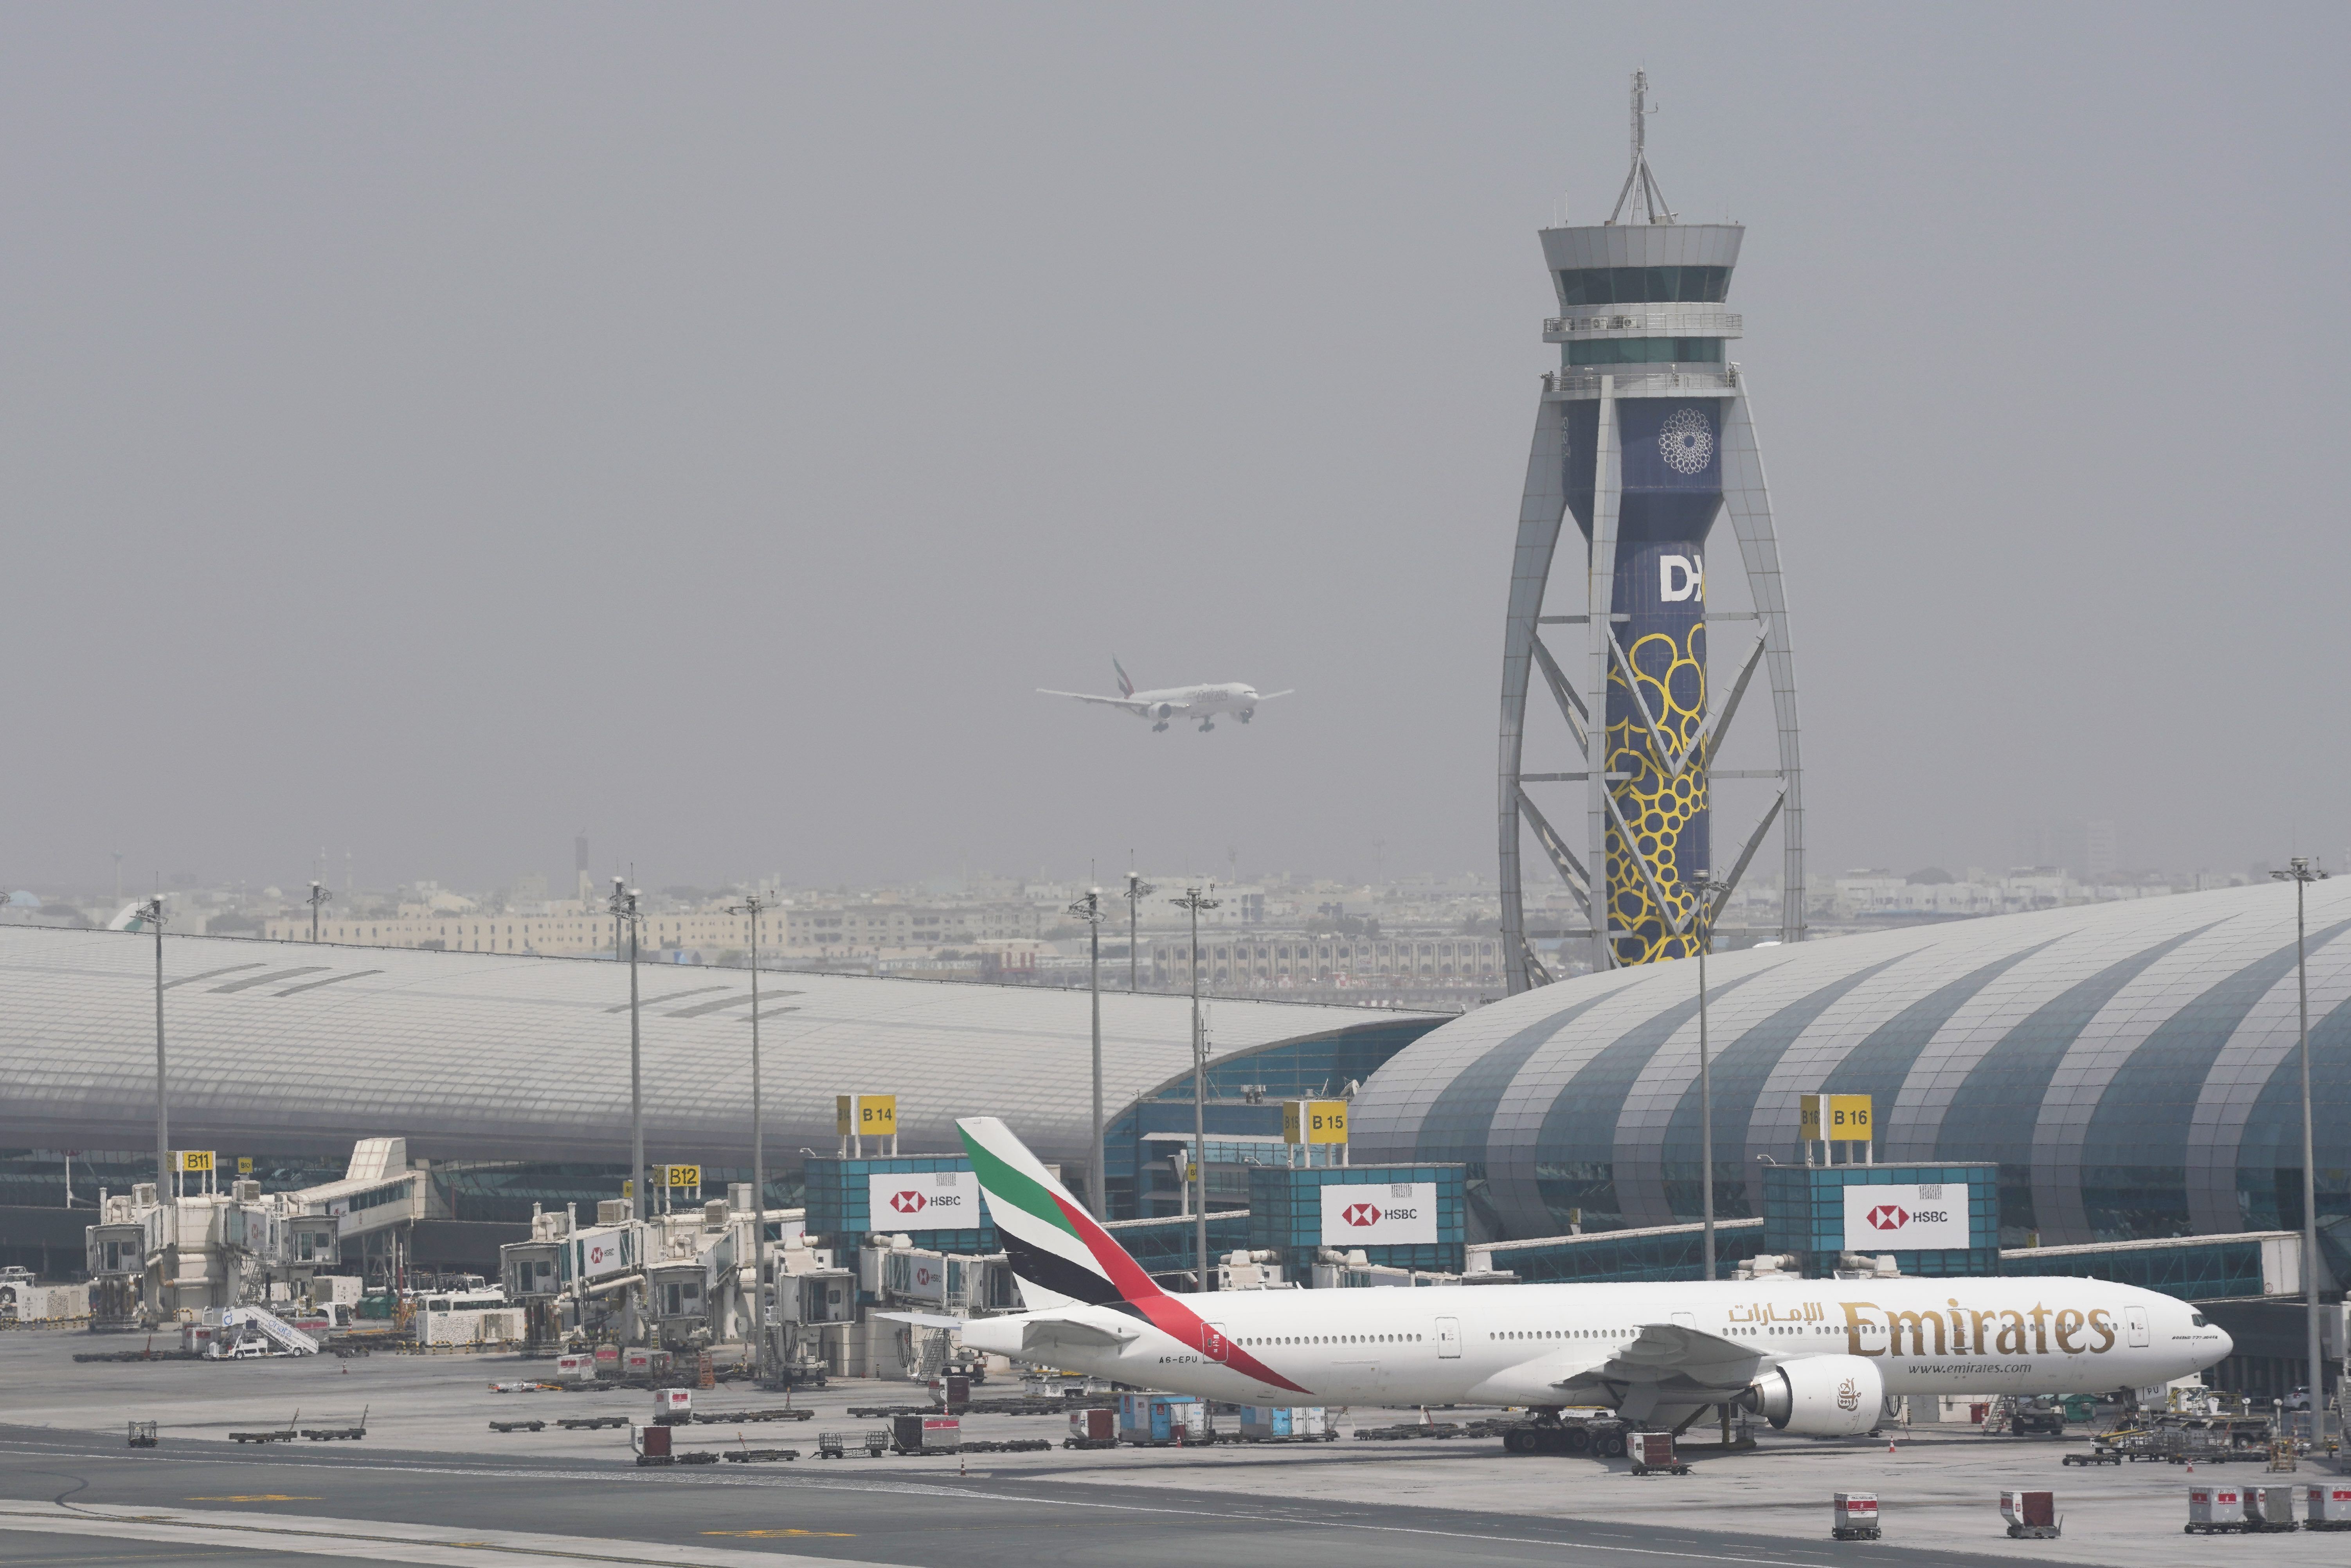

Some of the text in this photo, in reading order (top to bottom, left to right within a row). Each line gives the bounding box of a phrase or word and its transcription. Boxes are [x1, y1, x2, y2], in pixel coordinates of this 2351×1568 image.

[188, 1154, 209, 1169] B11
[670, 1168, 697, 1184] B12
[930, 1196, 961, 1206] HSBC
[1385, 1208, 1417, 1219] HSBC
[1913, 1211, 1948, 1223] HSBC
[1728, 1302, 1825, 1326] الإمارات
[268, 1320, 292, 1337] dnata
[1838, 1298, 2115, 1356] Emirates
[1909, 1362, 2032, 1374] www.emirates.com
[2147, 1386, 2159, 1395] PU
